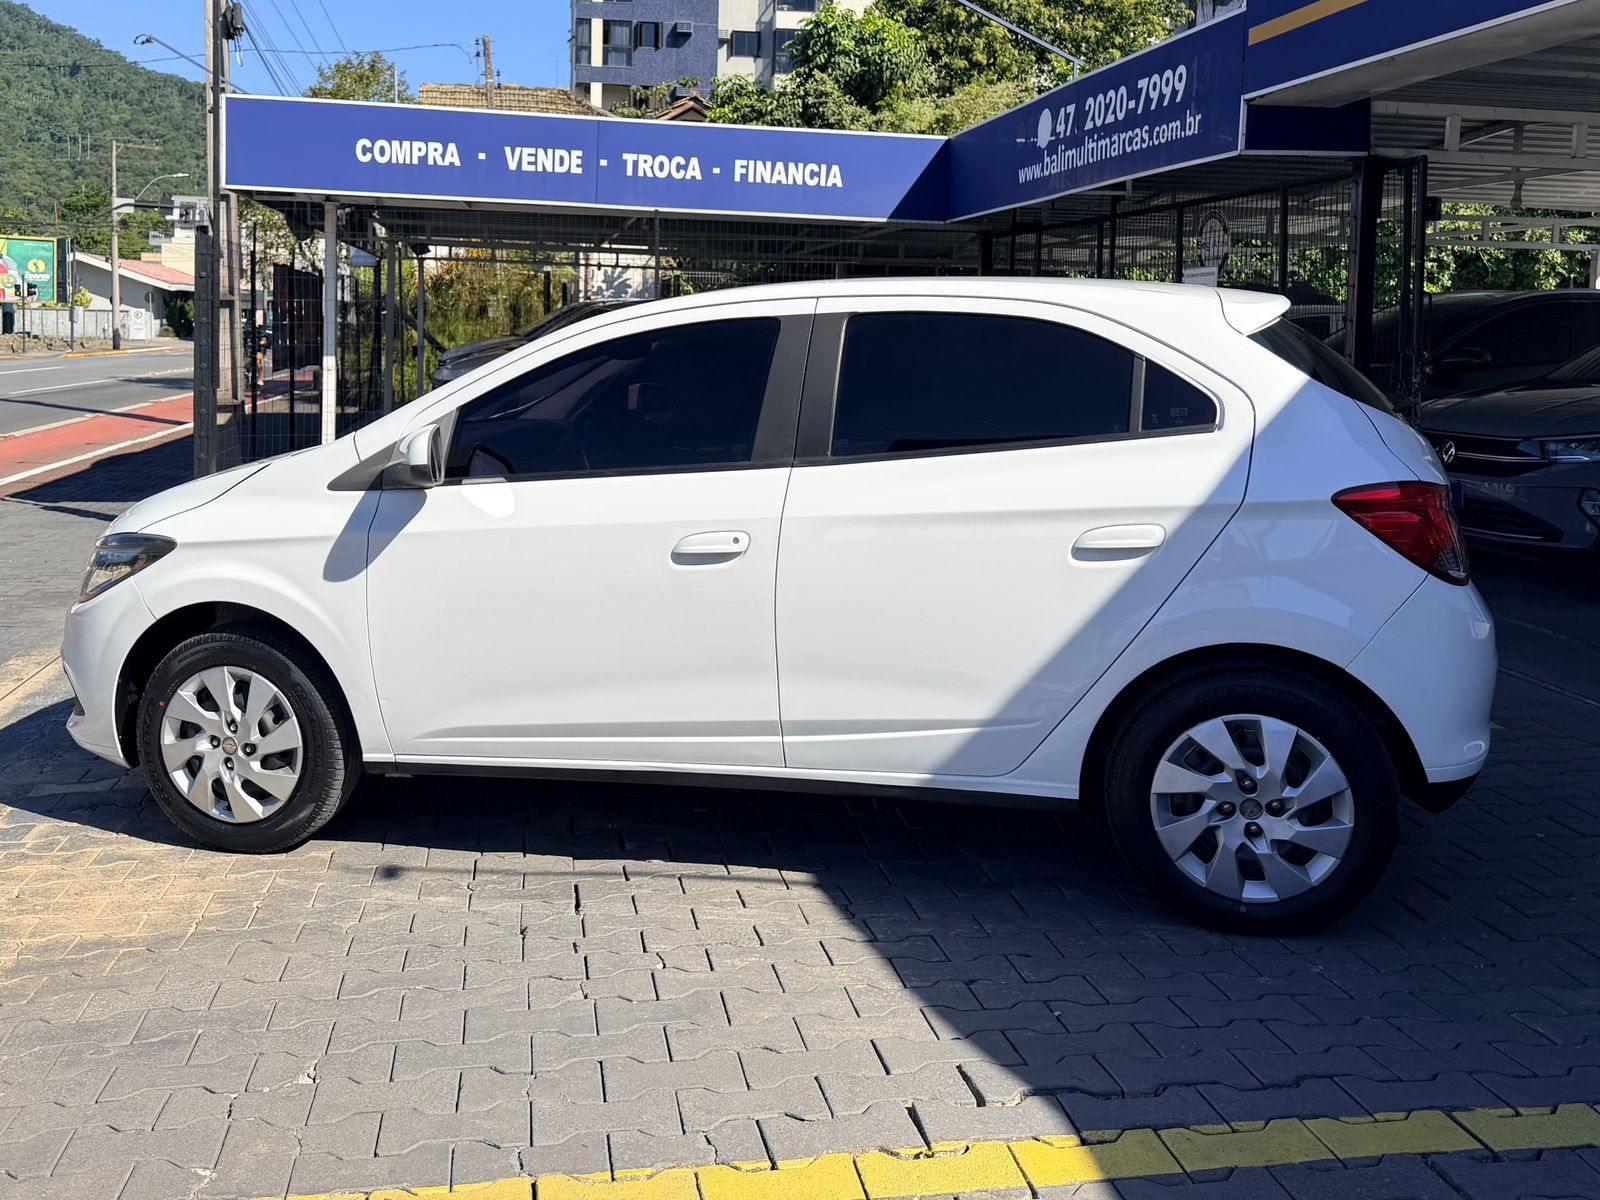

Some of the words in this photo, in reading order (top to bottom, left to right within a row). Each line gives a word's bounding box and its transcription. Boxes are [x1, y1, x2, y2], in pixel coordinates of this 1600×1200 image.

[1056, 103, 1076, 137] 47
[1084, 64, 1187, 131] 2020-7999
[355, 138, 461, 167] COMPRA
[504, 146, 583, 174] VENDE
[622, 153, 702, 180] TROCA
[734, 159, 843, 188] FINANCIA
[1018, 109, 1202, 184] www.balimultimarcas.com.br
